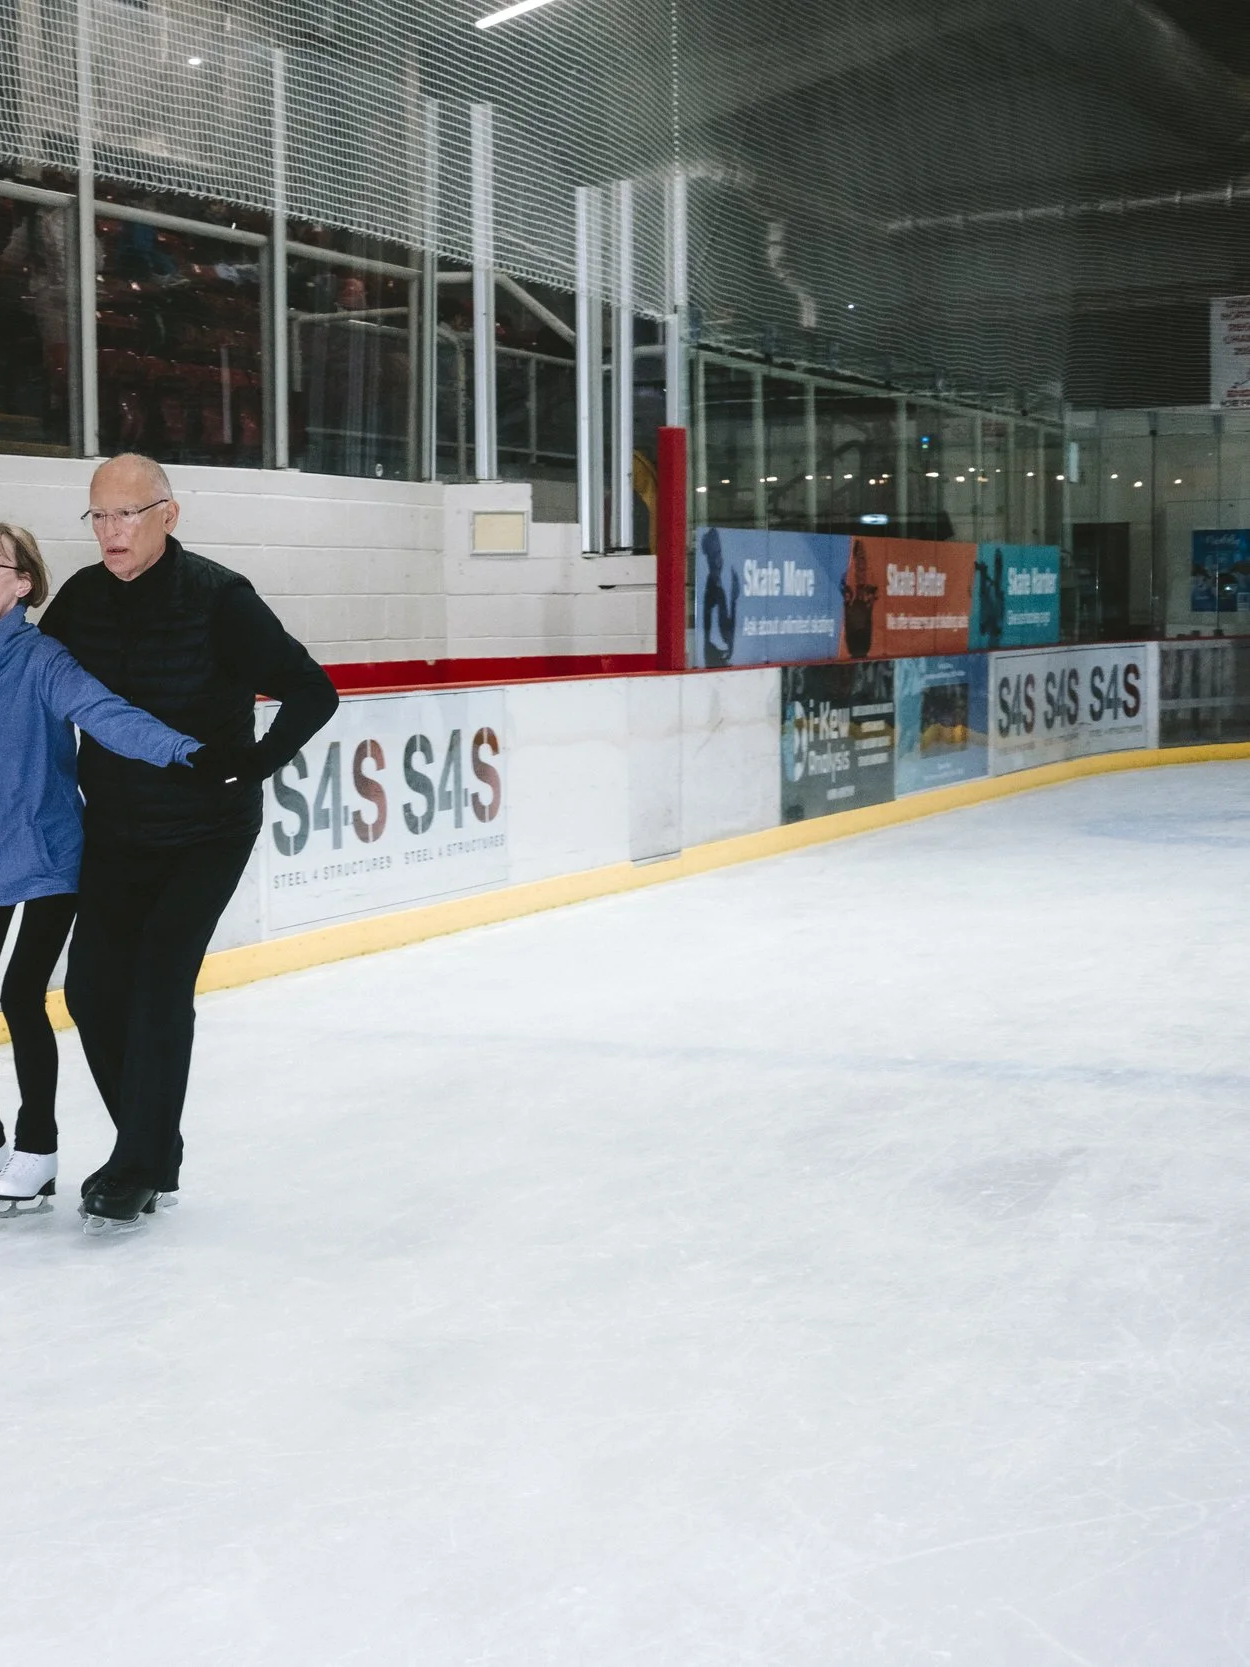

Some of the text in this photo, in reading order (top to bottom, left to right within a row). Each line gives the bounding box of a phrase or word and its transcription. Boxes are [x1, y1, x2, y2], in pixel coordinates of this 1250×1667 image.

[743, 559, 815, 597] Skate More
[886, 563, 947, 597] Skate Better
[1007, 567, 1030, 596] Skate
[998, 663, 1141, 738] S4S S4S S4S
[272, 738, 387, 857] S4S
[403, 726, 502, 835] S4S
[404, 848, 434, 866] STEEL
[447, 834, 506, 858] STRUCTURES
[273, 871, 308, 890] STEEL
[323, 855, 392, 881] STRUCTURES
